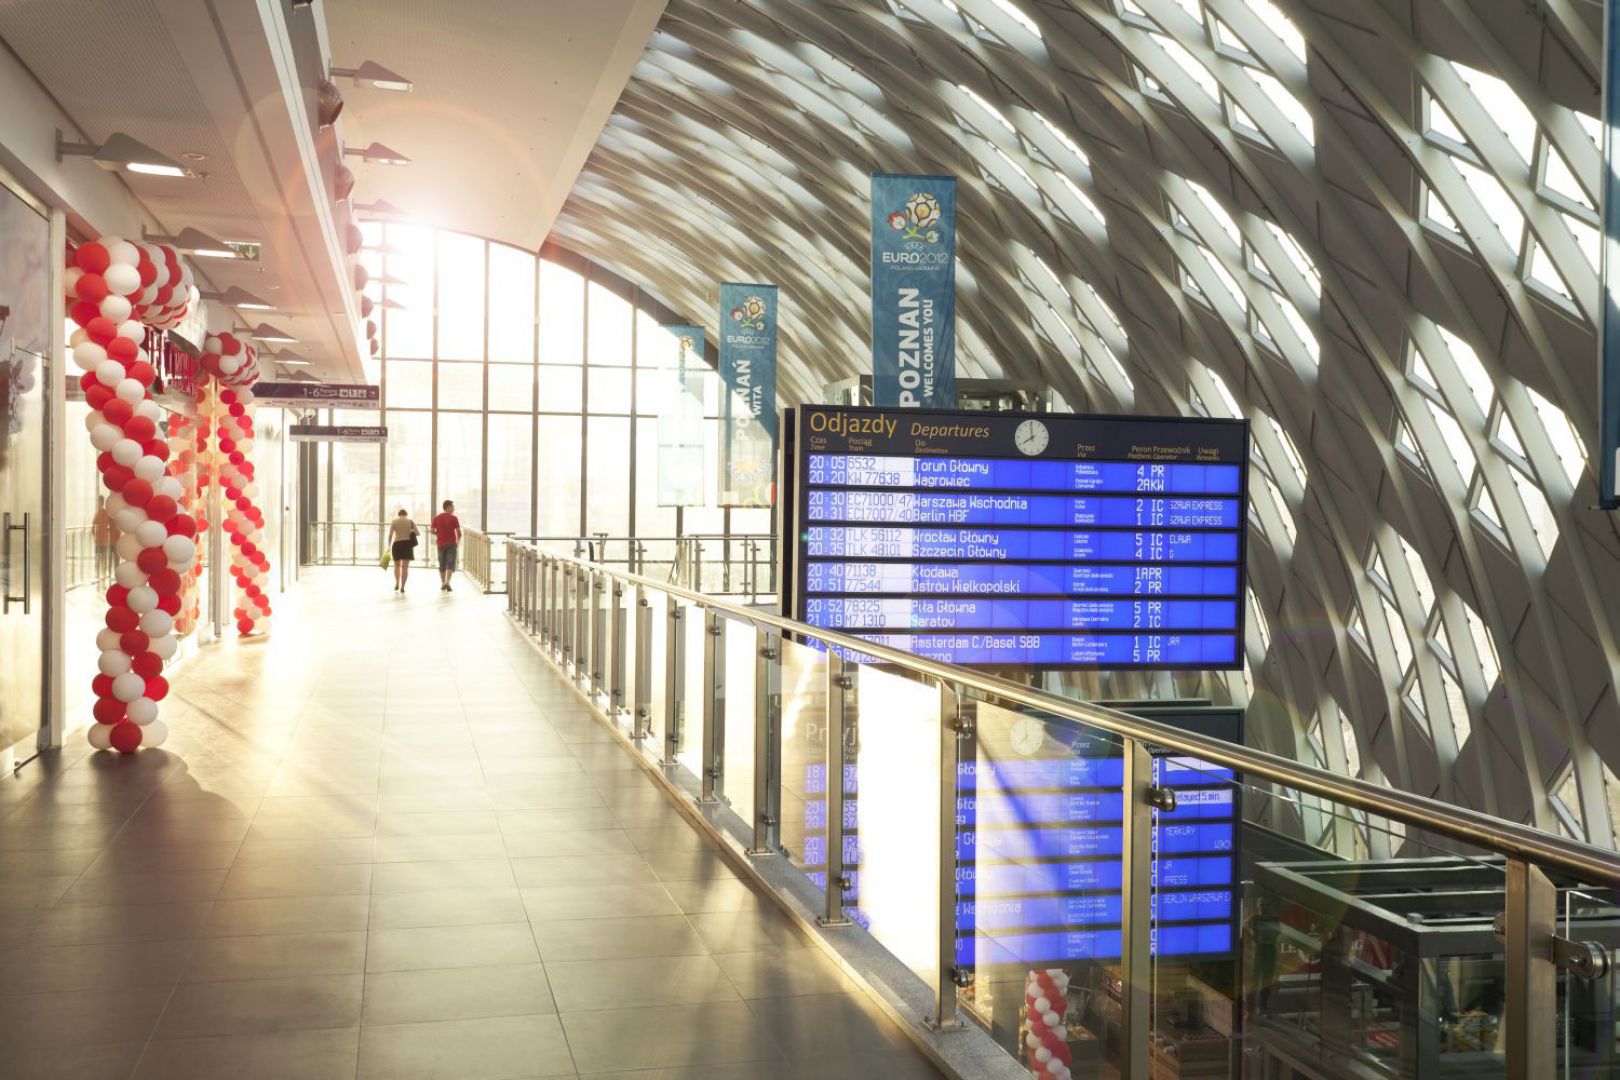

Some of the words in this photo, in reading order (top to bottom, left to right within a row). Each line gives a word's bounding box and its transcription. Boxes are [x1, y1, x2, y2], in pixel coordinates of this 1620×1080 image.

[923, 299, 934, 321] YOU
[923, 328, 934, 398] WELCOMES
[732, 359, 751, 441] PONAŃ
[753, 385, 763, 416] WITA
[810, 412, 897, 438] Odjazdy
[911, 422, 990, 439] Departures
[848, 457, 875, 470] 6532
[1137, 465, 1144, 477] 4
[1151, 465, 1164, 477] PR
[866, 472, 900, 485] 77638
[913, 495, 966, 508] Warszawa
[970, 496, 1027, 509] Wschodnia
[1136, 500, 1143, 512] 2
[1151, 500, 1163, 512] IC
[914, 509, 945, 522] Berlin
[948, 510, 969, 522] HBF
[1137, 514, 1142, 526] 1
[1151, 514, 1163, 526] IC
[913, 530, 956, 543] Wrocław
[1136, 534, 1143, 546] 5
[1150, 534, 1163, 546] IC
[912, 544, 964, 557] Szczecin
[1136, 548, 1143, 560] 4
[1150, 548, 1163, 560] IC
[846, 565, 876, 577] 71138
[912, 565, 959, 578] Kłodawa
[846, 579, 880, 592] 77544
[952, 580, 1020, 593] Wielkopolski
[1134, 581, 1141, 593] 2
[1148, 581, 1162, 593] PR
[1134, 602, 1141, 614] 5
[1148, 602, 1162, 614] PR
[911, 614, 955, 627] Saratov
[1134, 616, 1141, 628] 2
[1149, 616, 1161, 628] IC
[910, 635, 969, 649] Amsterdam
[1019, 635, 1040, 649] SBB
[1134, 636, 1139, 648] 1
[1149, 636, 1160, 648] IC
[1133, 650, 1140, 662] 5
[1147, 650, 1160, 662] PR
[1175, 792, 1201, 802] elayed
